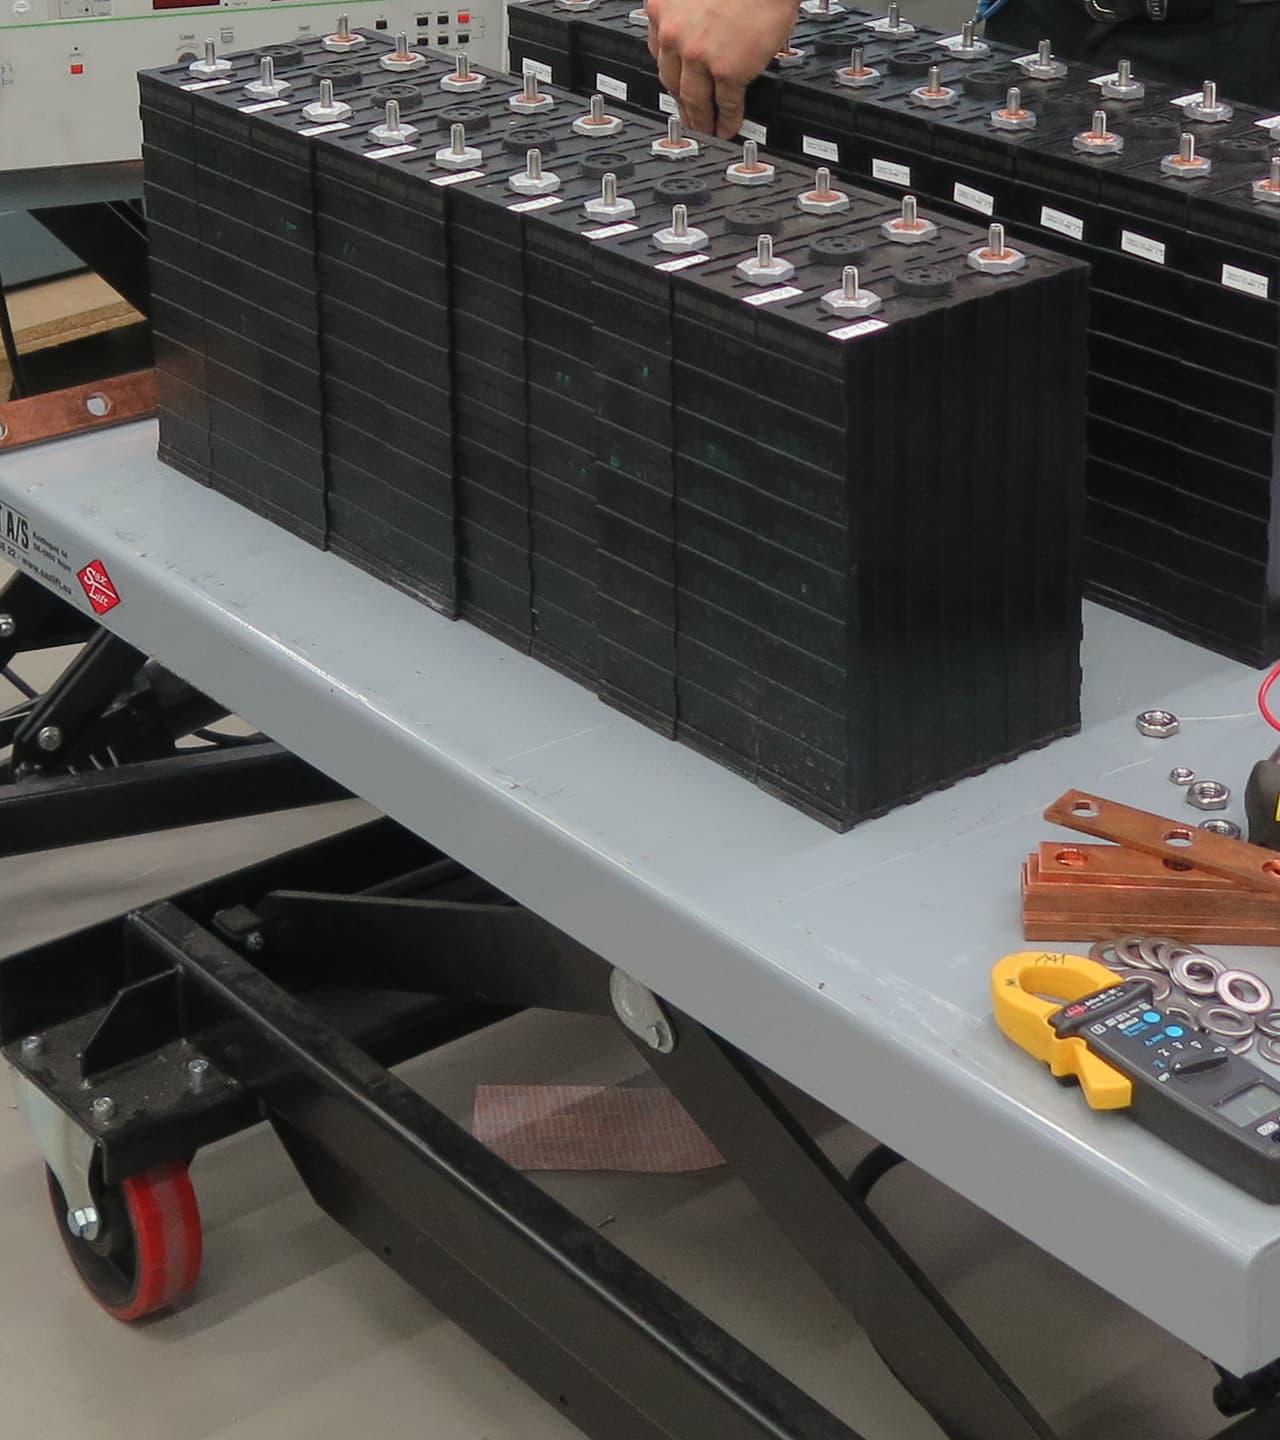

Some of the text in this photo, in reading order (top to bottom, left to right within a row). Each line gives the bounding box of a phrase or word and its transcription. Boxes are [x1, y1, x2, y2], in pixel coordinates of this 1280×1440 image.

[7, 511, 29, 550] A/S
[8, 546, 17, 559] 22
[84, 567, 108, 585] Sax
[88, 582, 110, 607] Lift
